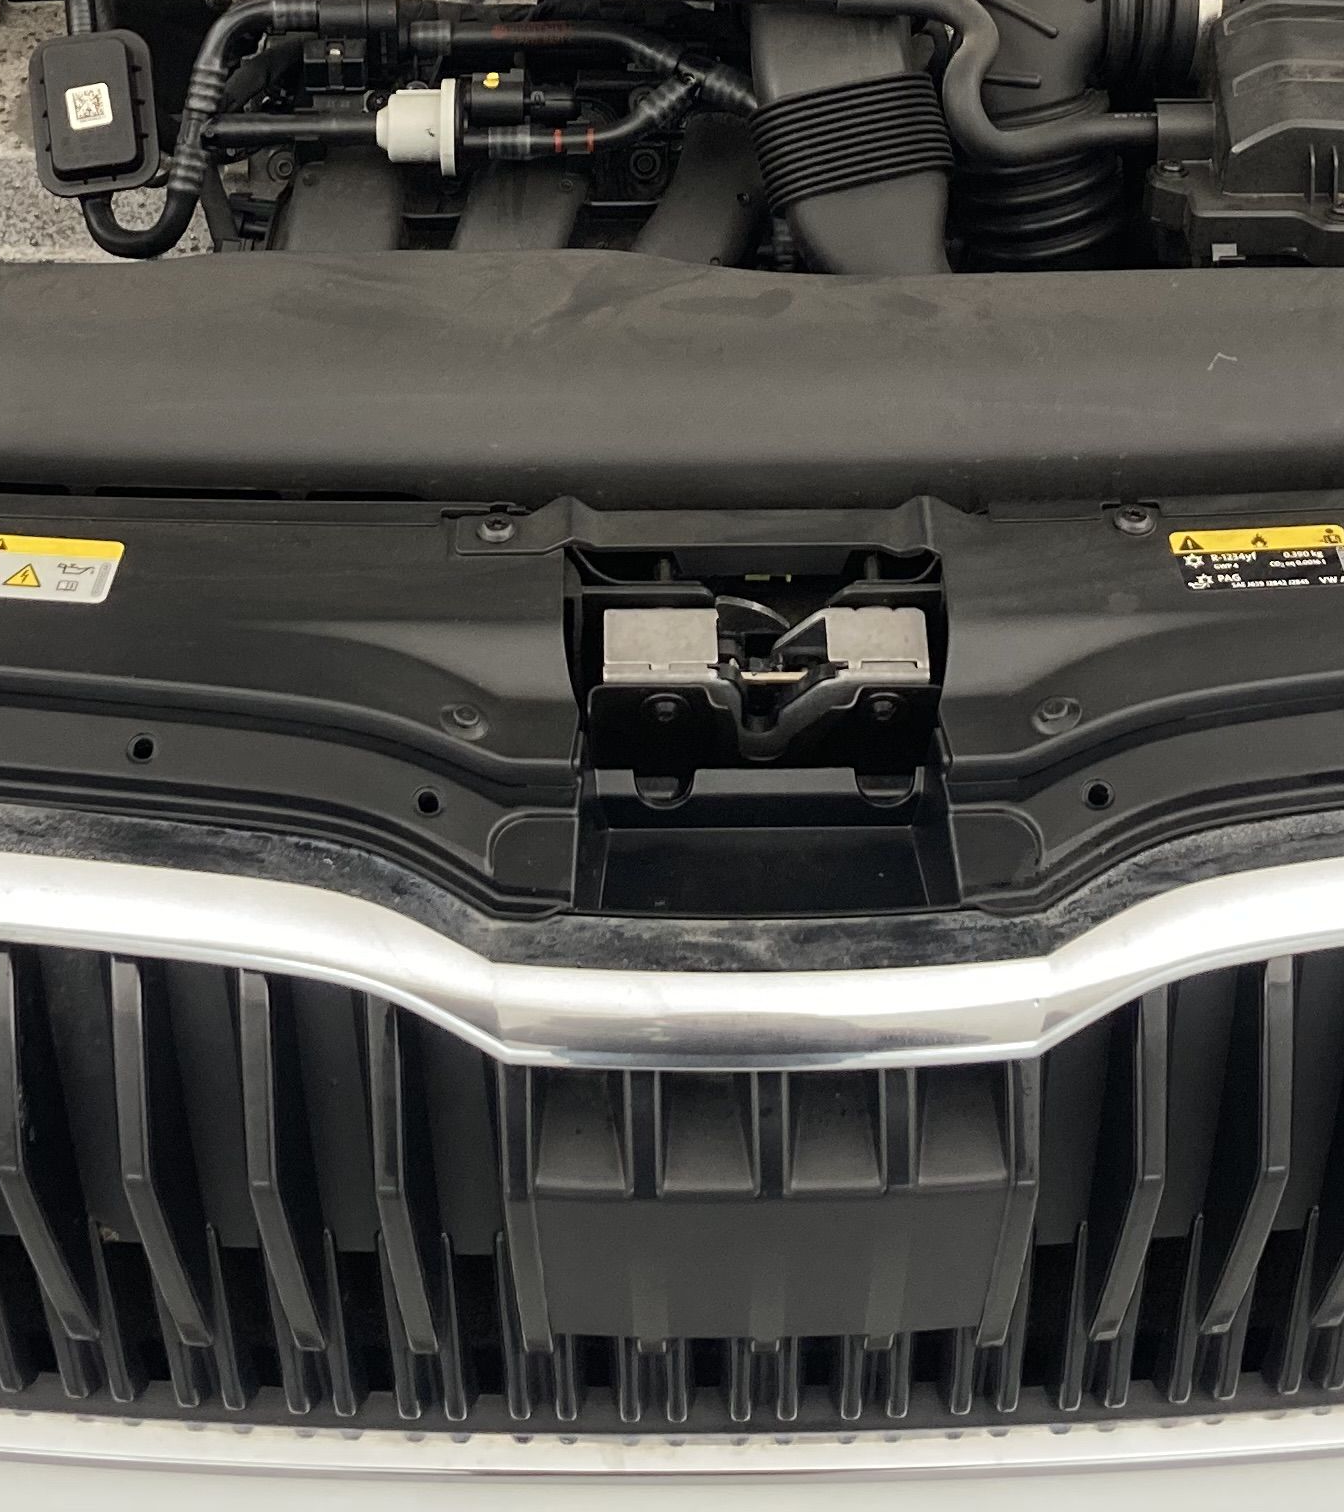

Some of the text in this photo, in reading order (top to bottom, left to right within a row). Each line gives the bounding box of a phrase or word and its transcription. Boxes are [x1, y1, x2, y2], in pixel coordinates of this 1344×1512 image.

[1310, 549, 1324, 559] kg
[1217, 573, 1242, 583] PAG
[1318, 575, 1338, 584] VW
